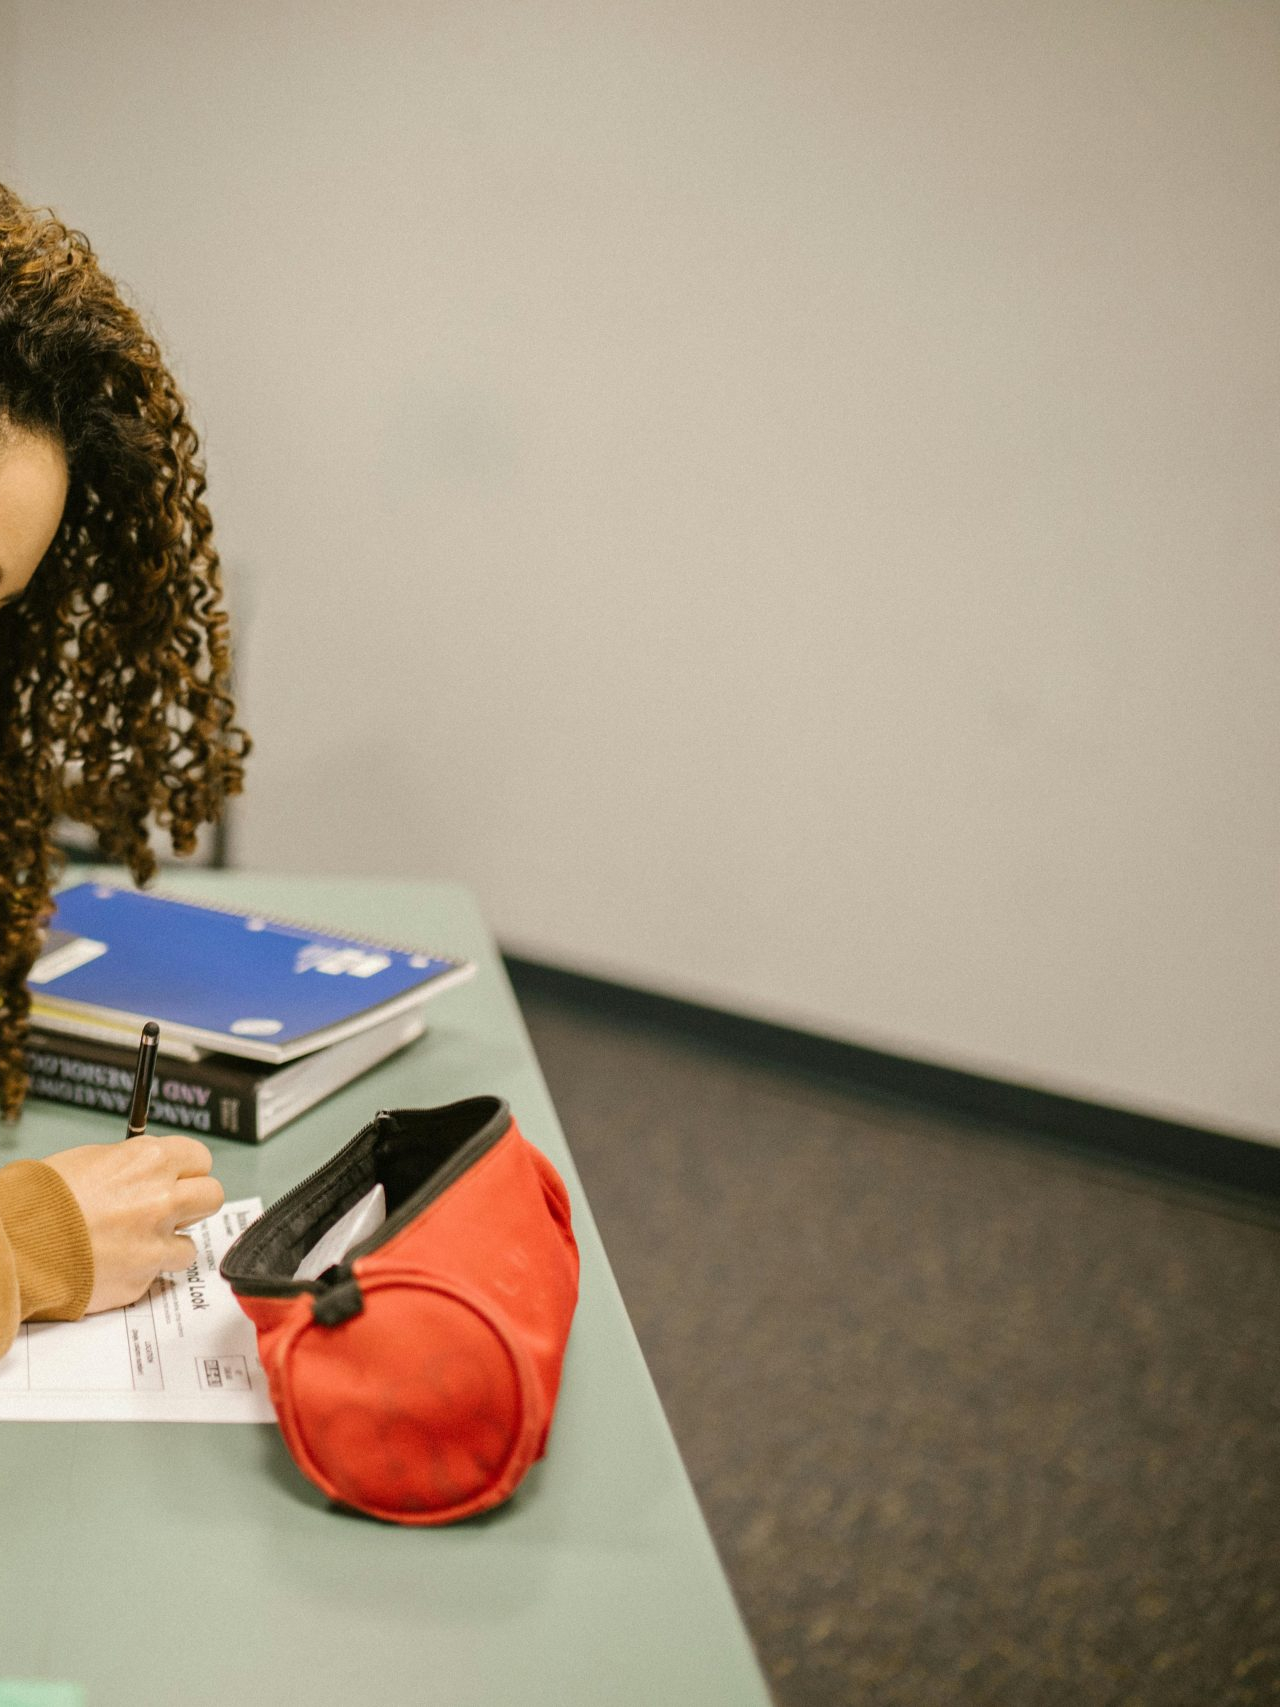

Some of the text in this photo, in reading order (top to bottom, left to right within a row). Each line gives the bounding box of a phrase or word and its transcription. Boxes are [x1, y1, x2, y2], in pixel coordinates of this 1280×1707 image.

[162, 1080, 211, 1107] AND
[146, 1100, 211, 1132] DANC
[189, 1286, 210, 1310] Look
